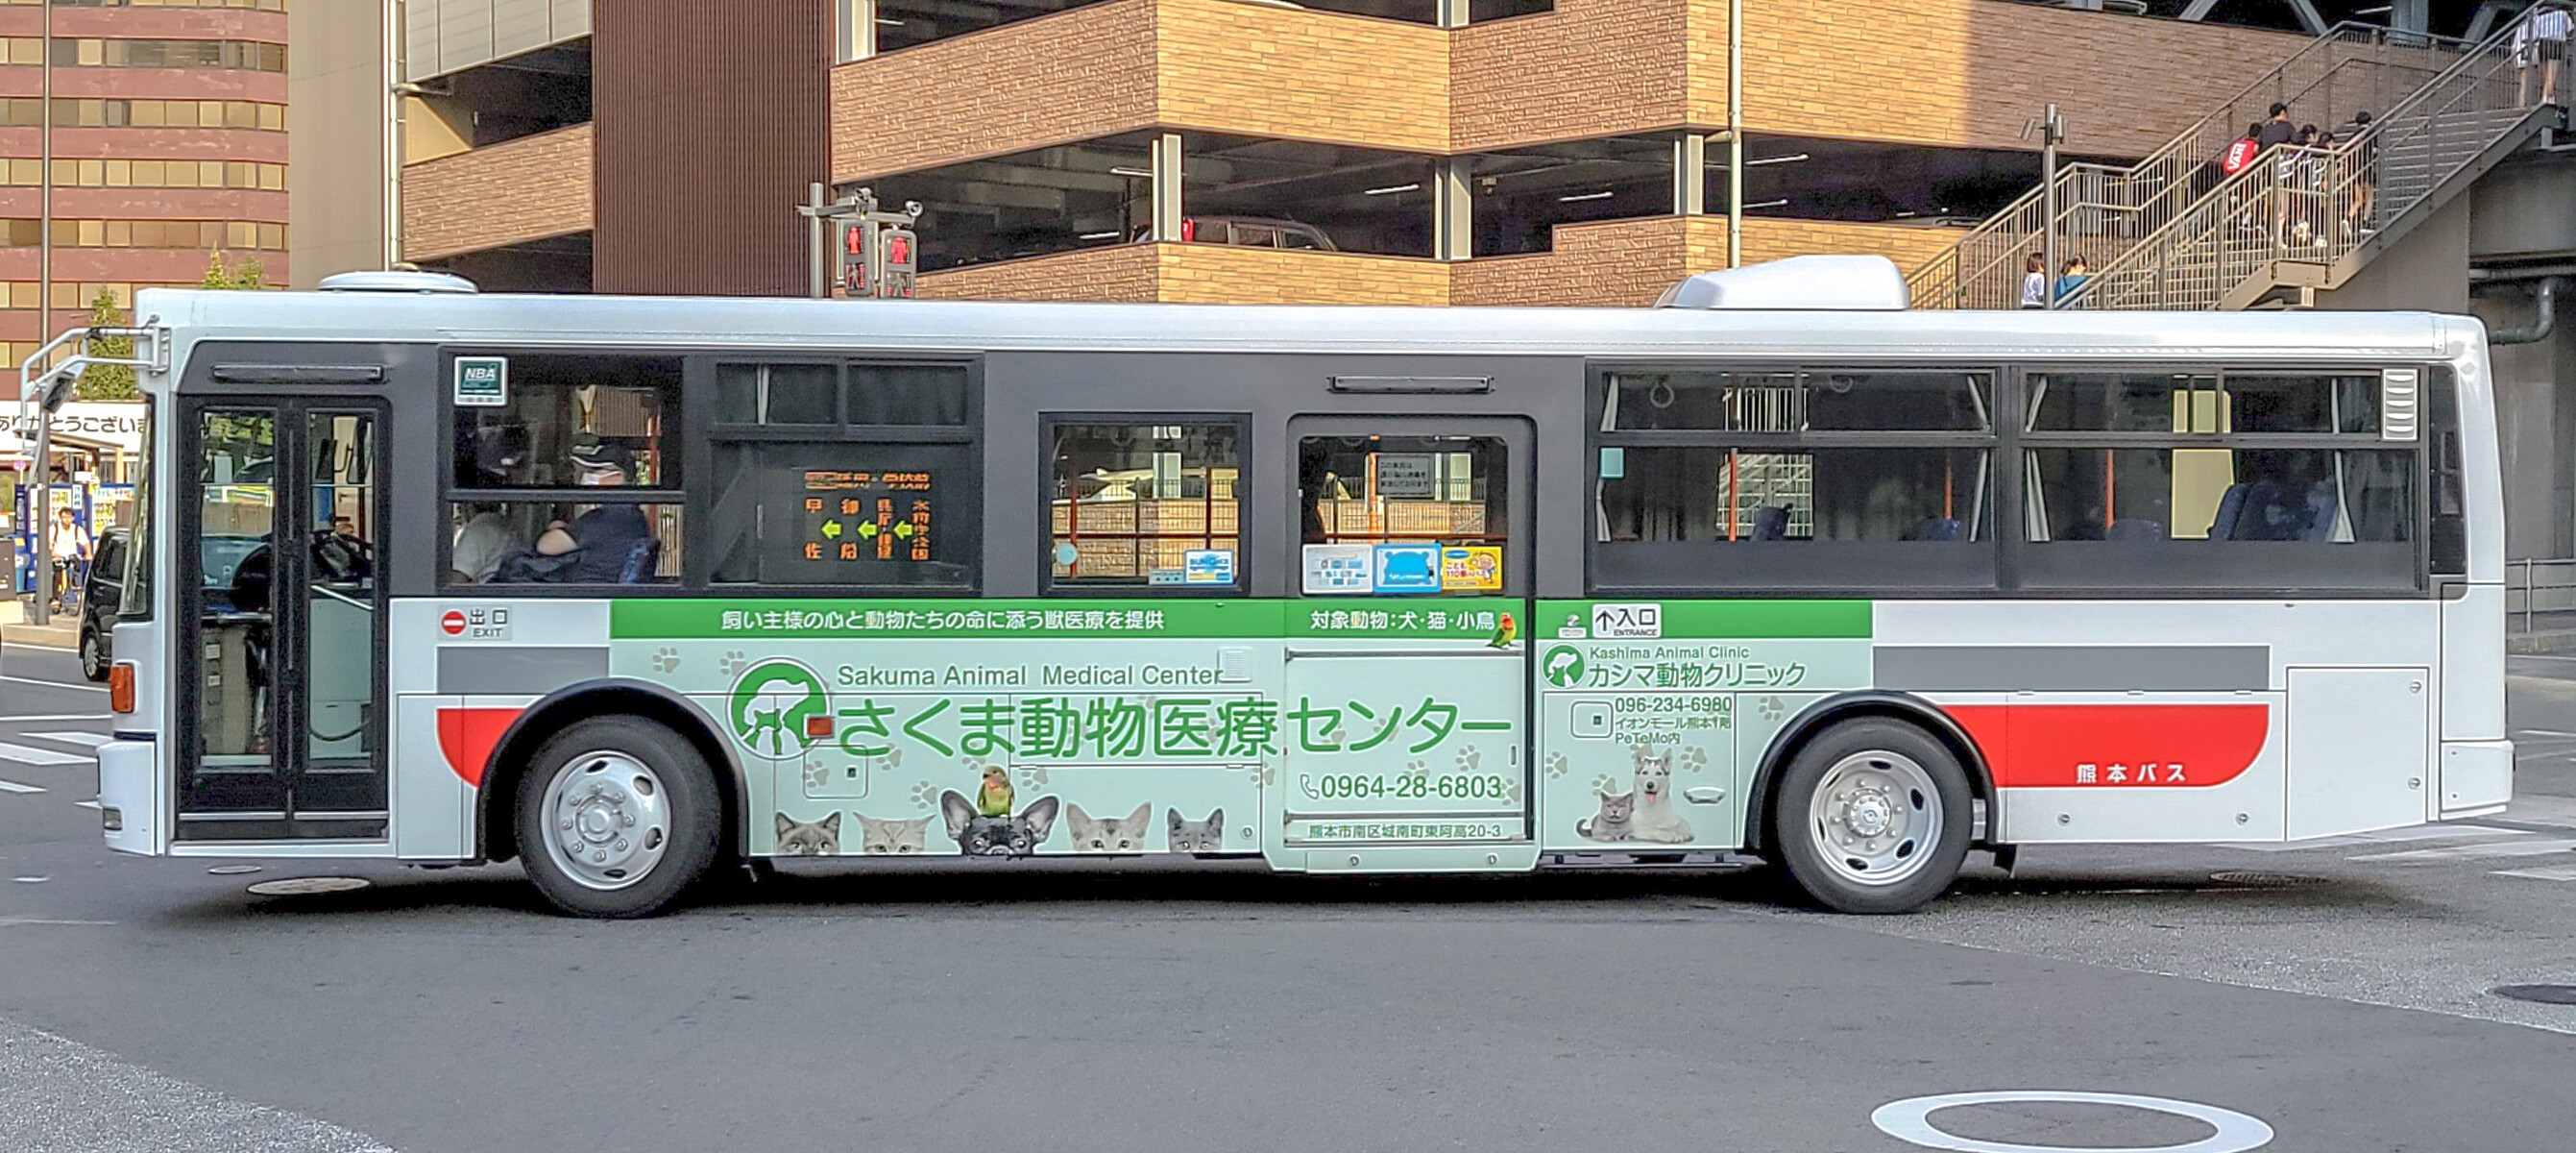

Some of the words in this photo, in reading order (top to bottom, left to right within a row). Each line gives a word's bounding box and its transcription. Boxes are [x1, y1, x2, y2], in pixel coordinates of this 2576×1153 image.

[466, 367, 496, 379] NBA
[471, 608, 507, 625] 出口
[721, 610, 1165, 631] 飼い主様の心と動物たちの命に添う獣医療を提供
[1616, 608, 1656, 627] 入口
[474, 627, 503, 637] EXIT
[1614, 628, 1658, 637] ENTRANCE
[1590, 647, 1650, 660] Kashima
[1655, 647, 1705, 660] Animal
[1709, 647, 1749, 660] Clinic
[838, 665, 936, 687] Sakuma
[943, 665, 1027, 687] Animal
[1042, 665, 1133, 687] Medical
[1141, 665, 1224, 687] Center
[1588, 663, 1806, 689] カシマ動物クリニック
[1615, 697, 1733, 712] 096-234-6980
[838, 698, 1512, 756] さくま動物医療センター
[1615, 732, 1681, 745] PeTeMo内
[2077, 764, 2186, 783] 熊本バス
[1321, 774, 1502, 799] 0964-28-6803
[1308, 823, 1501, 839] 熊本市南区城南町東阿高20-3
